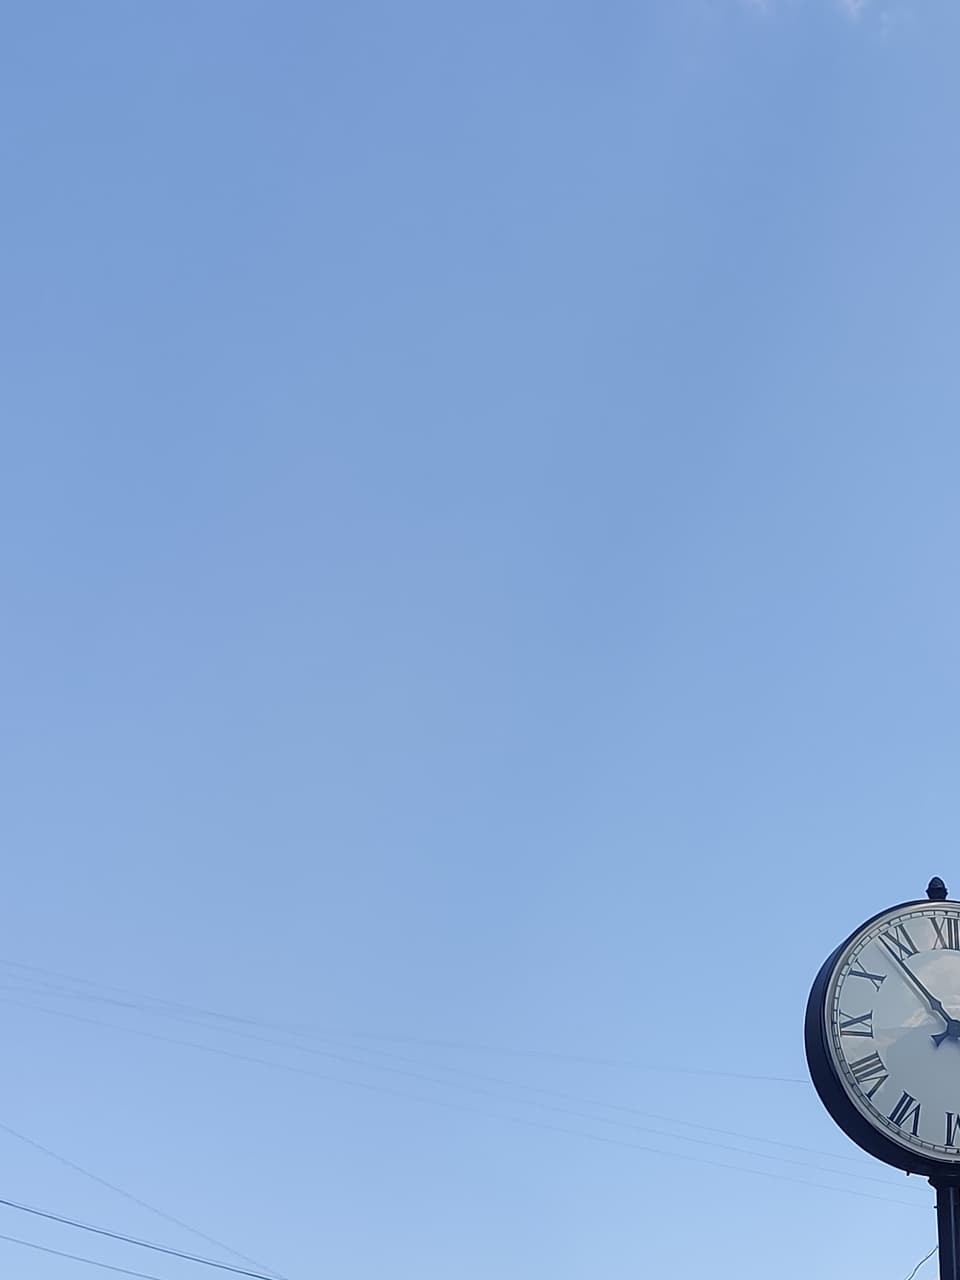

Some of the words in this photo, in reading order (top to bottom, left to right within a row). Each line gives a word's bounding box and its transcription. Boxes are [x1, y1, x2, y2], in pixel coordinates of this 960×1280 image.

[884, 923, 920, 962] XI
[928, 917, 960, 951] XII
[848, 958, 887, 992] X
[839, 1010, 874, 1039] IX
[849, 1050, 889, 1101] VIII
[887, 1090, 921, 1138] VII
